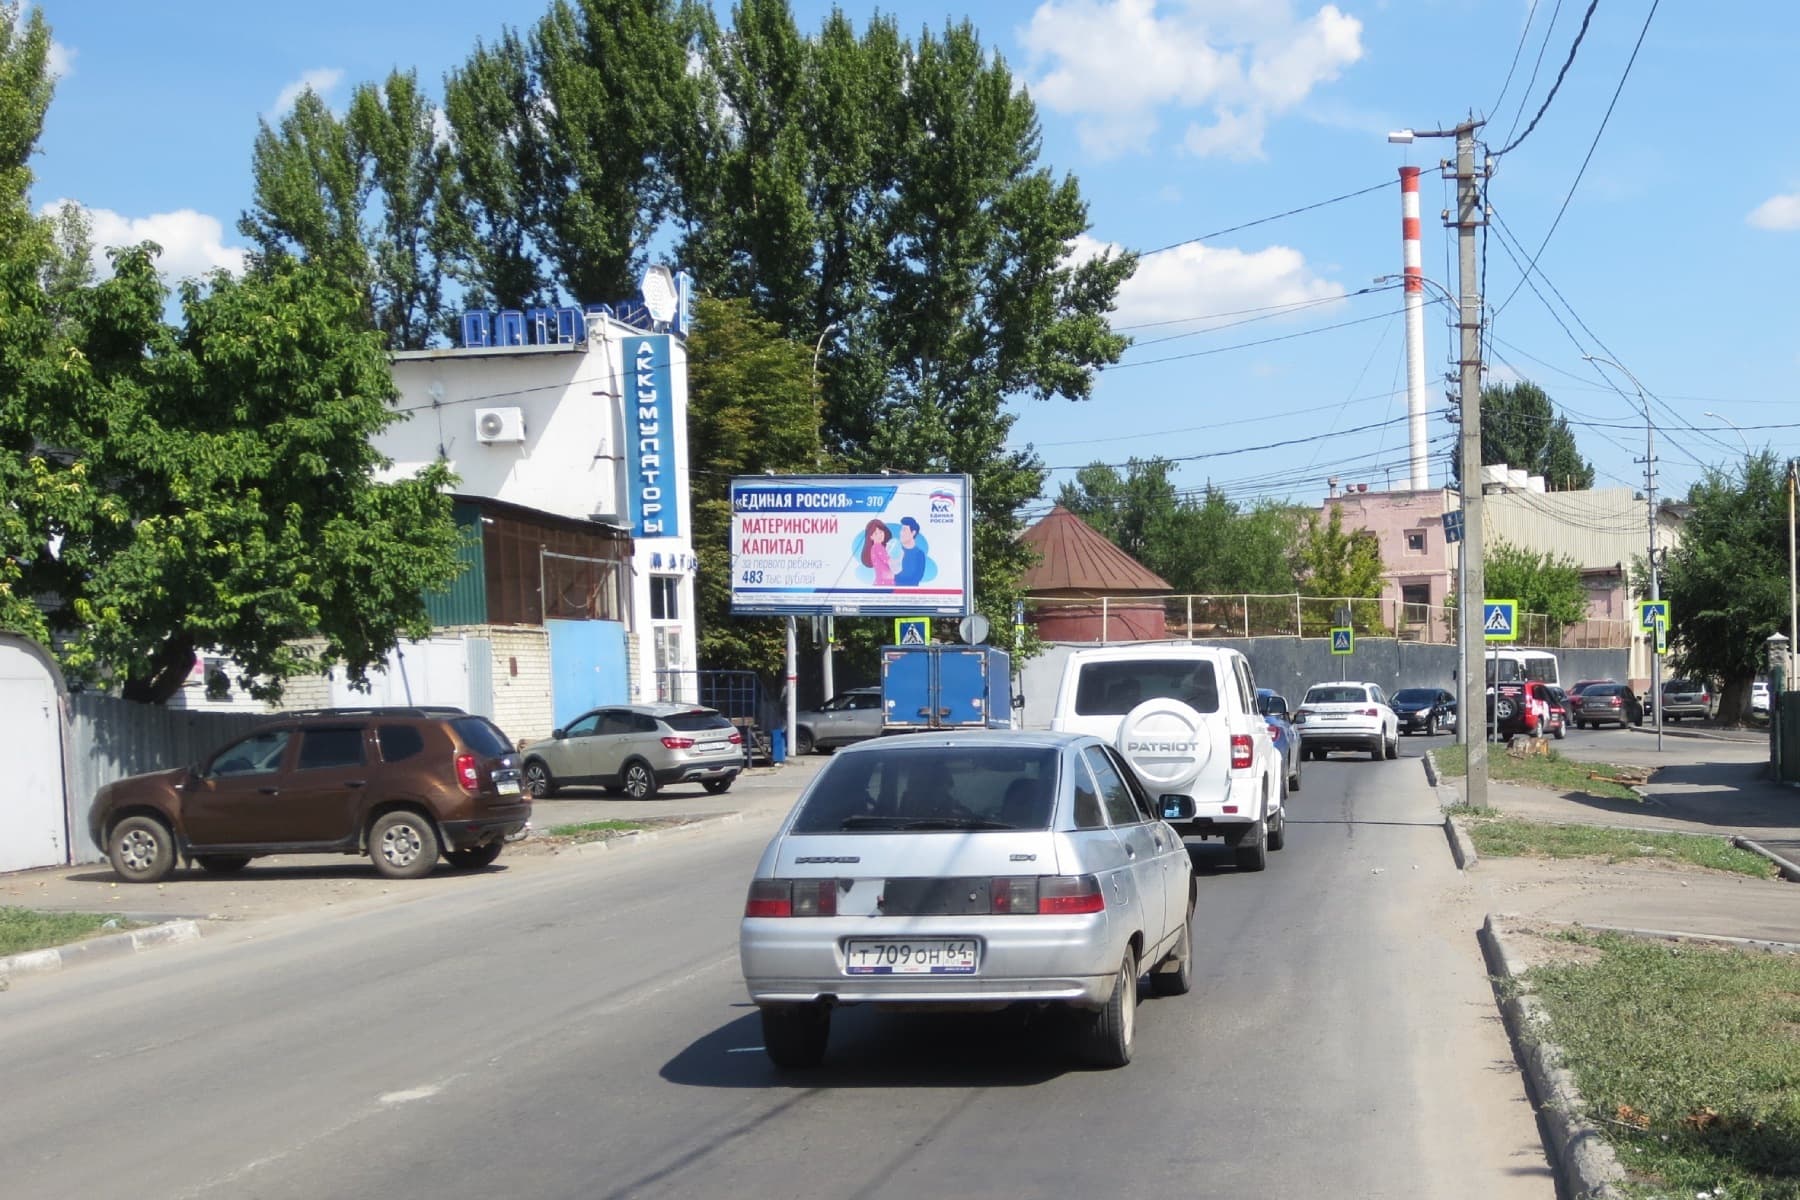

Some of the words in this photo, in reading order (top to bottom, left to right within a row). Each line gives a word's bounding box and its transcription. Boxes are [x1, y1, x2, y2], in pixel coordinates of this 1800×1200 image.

[636, 341, 664, 533] АККУМУЛЯТОРЫ
[735, 493, 792, 510] «ЕДИНАЯ
[796, 493, 853, 508] РОССИЯ»
[742, 514, 838, 534] МАТЕРИНСКИЙ
[742, 538, 804, 554] КАПИТАЛ
[753, 559, 785, 570] первого
[742, 570, 763, 584] 483
[1128, 742, 1200, 752] PATRIOT
